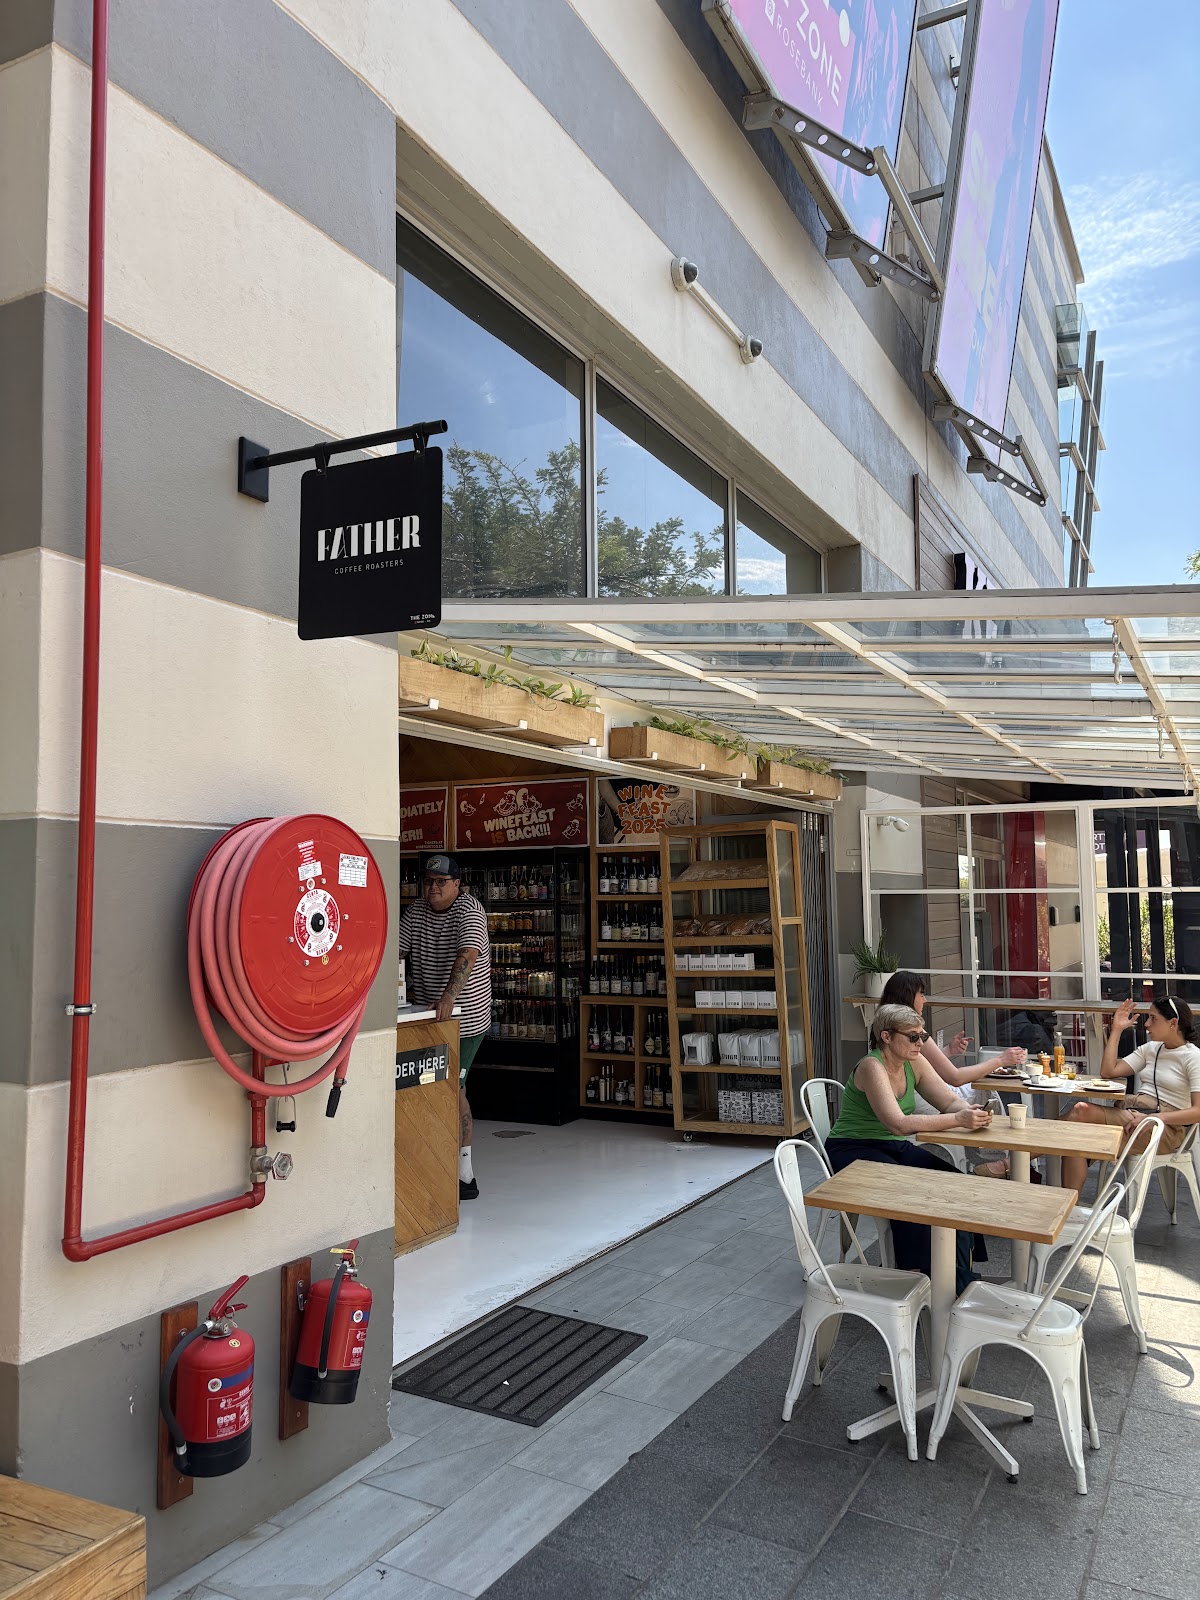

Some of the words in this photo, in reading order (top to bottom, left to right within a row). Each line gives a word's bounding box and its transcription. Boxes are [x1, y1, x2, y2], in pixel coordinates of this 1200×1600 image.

[796, 0, 842, 107] ZONE
[776, 14, 824, 113] ROSEBANK
[317, 514, 422, 562] FATHER
[334, 563, 363, 575] COFFEE
[365, 559, 404, 571] ROASTERS
[617, 783, 669, 802] WINE
[617, 801, 672, 819] FEAST
[483, 807, 556, 833] WINEFEAST
[620, 818, 666, 835] 2025
[400, 828, 424, 843] ER!!
[490, 831, 505, 845] IS
[506, 822, 552, 842] BACK!!!
[418, 1055, 445, 1074] HERE
